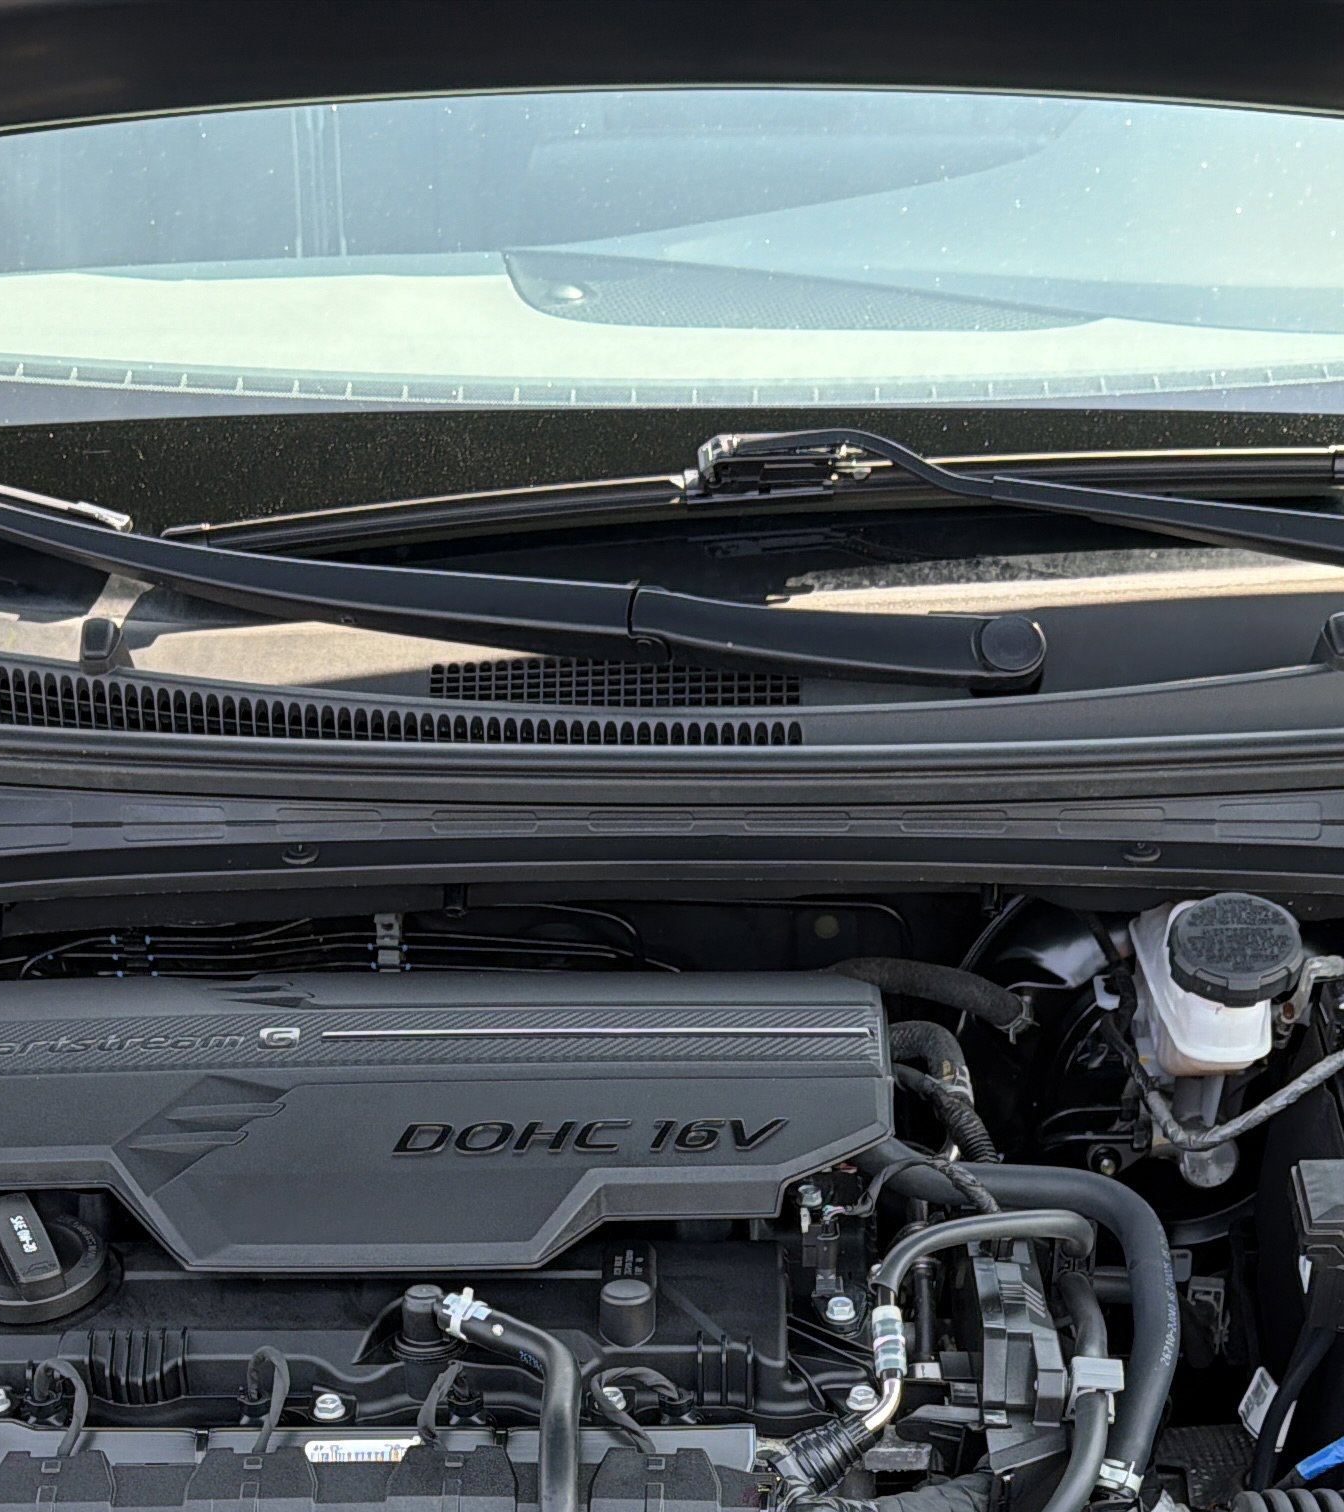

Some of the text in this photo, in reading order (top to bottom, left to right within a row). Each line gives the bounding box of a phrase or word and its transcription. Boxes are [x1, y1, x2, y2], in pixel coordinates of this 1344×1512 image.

[260, 1028, 299, 1049] G
[392, 1117, 789, 1156] DOHC 16V
